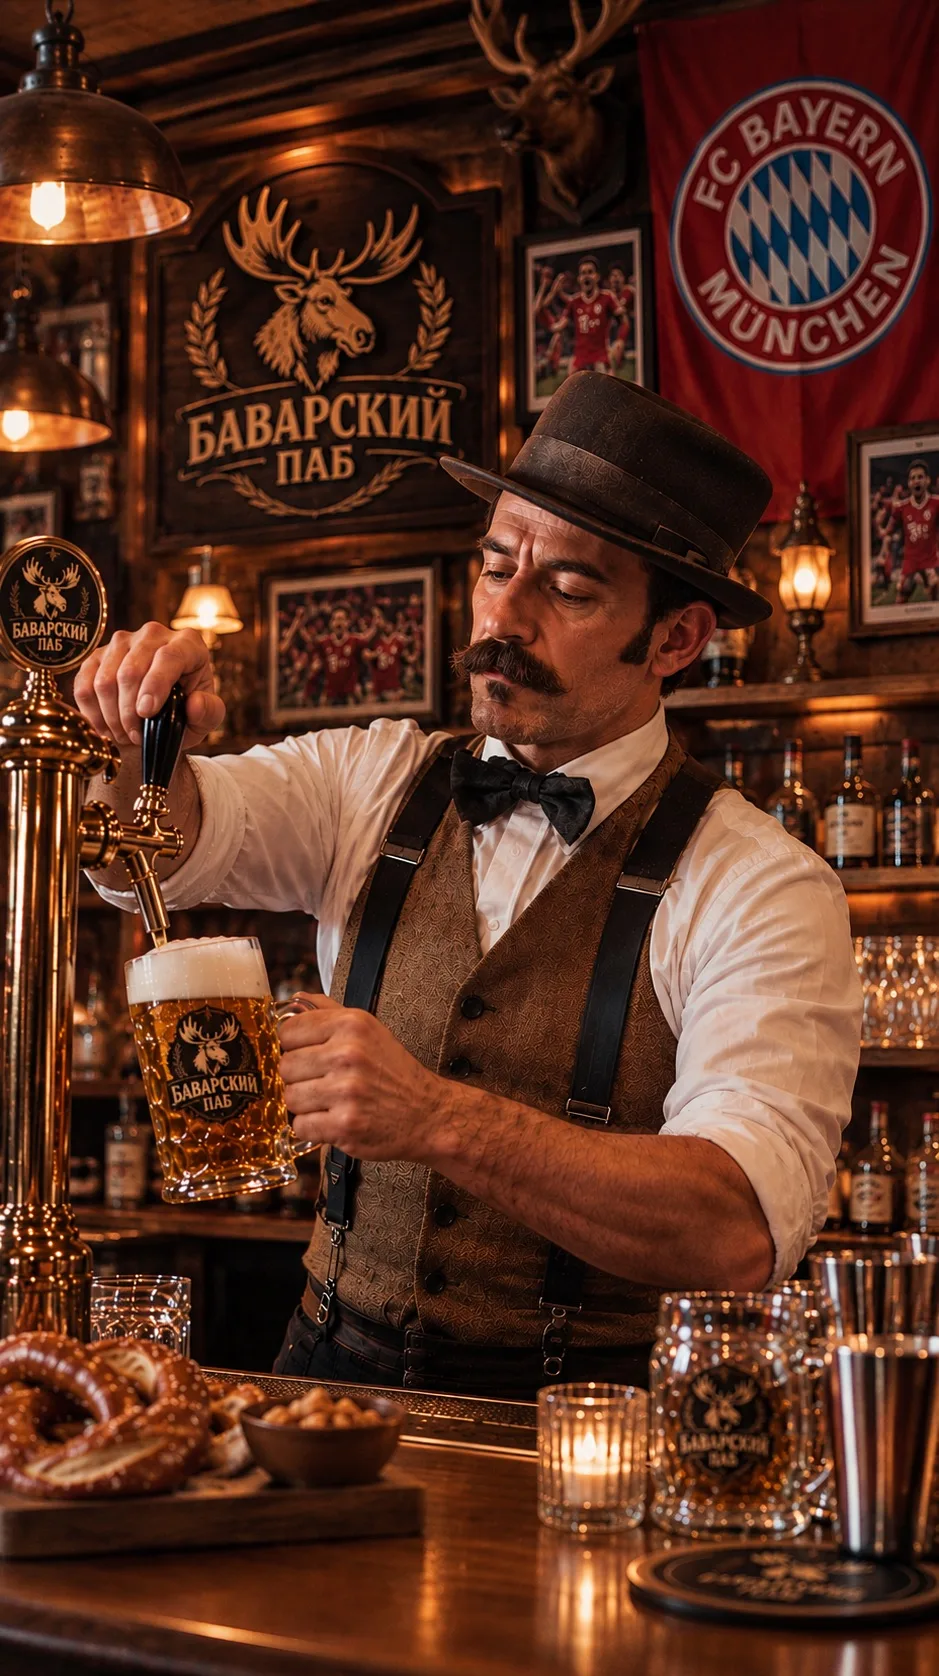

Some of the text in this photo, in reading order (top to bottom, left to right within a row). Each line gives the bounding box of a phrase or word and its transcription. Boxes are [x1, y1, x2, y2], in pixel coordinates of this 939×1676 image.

[693, 97, 907, 212] FC BAYERN
[697, 244, 910, 356] MÜNCHEN
[187, 386, 453, 466] БАВАРСКИЙ
[276, 444, 355, 486] ПАБ
[12, 621, 89, 643] БАВАРСКИЙ
[37, 637, 63, 652] ПАБ
[171, 1072, 259, 1105] БАВАРСКИЙ
[203, 1093, 233, 1112] ПАБ
